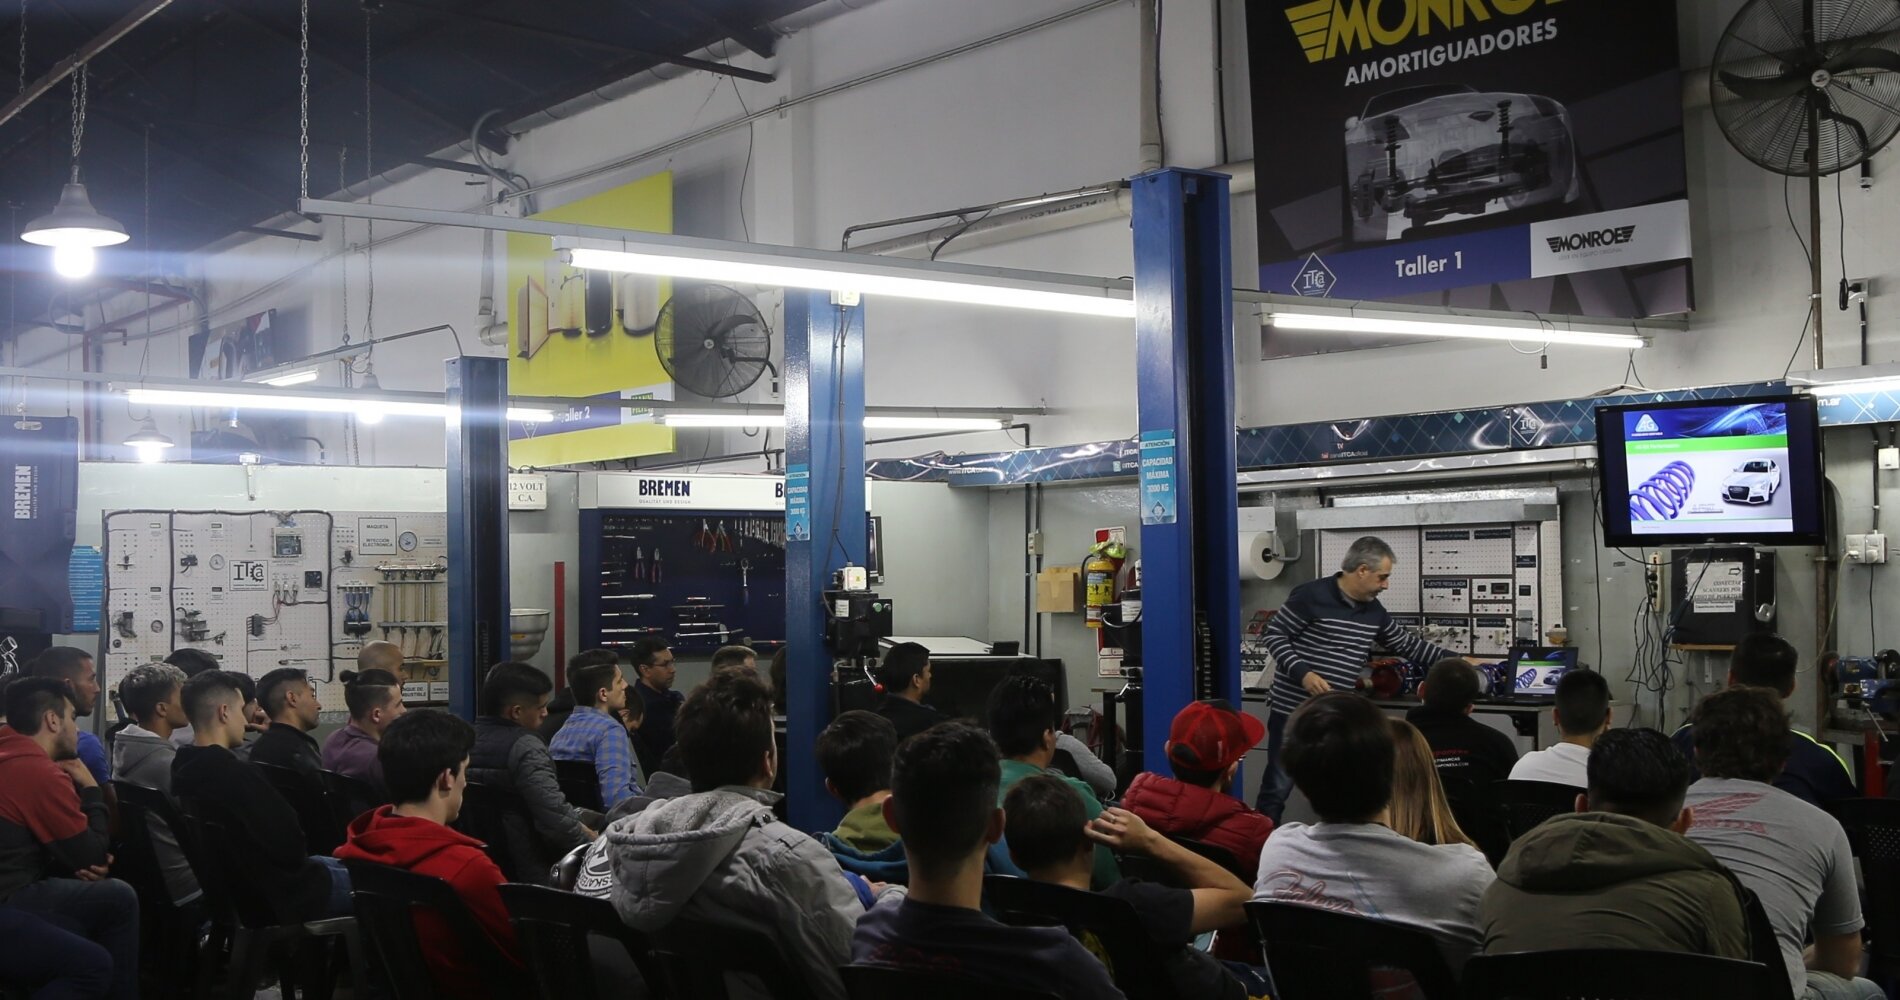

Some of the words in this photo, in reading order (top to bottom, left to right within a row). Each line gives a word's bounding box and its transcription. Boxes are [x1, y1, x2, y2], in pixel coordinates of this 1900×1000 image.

[1344, 18, 1558, 87] AMORTIGUADORES
[1546, 225, 1636, 253] MONROE
[1395, 255, 1447, 278] Taller
[1454, 251, 1462, 269] 1
[584, 406, 590, 419] 2
[1142, 457, 1173, 467] CAPACIDAD
[15, 465, 31, 519] BREMEN
[520, 482, 544, 490] VOLT
[639, 479, 690, 496] BREMEN
